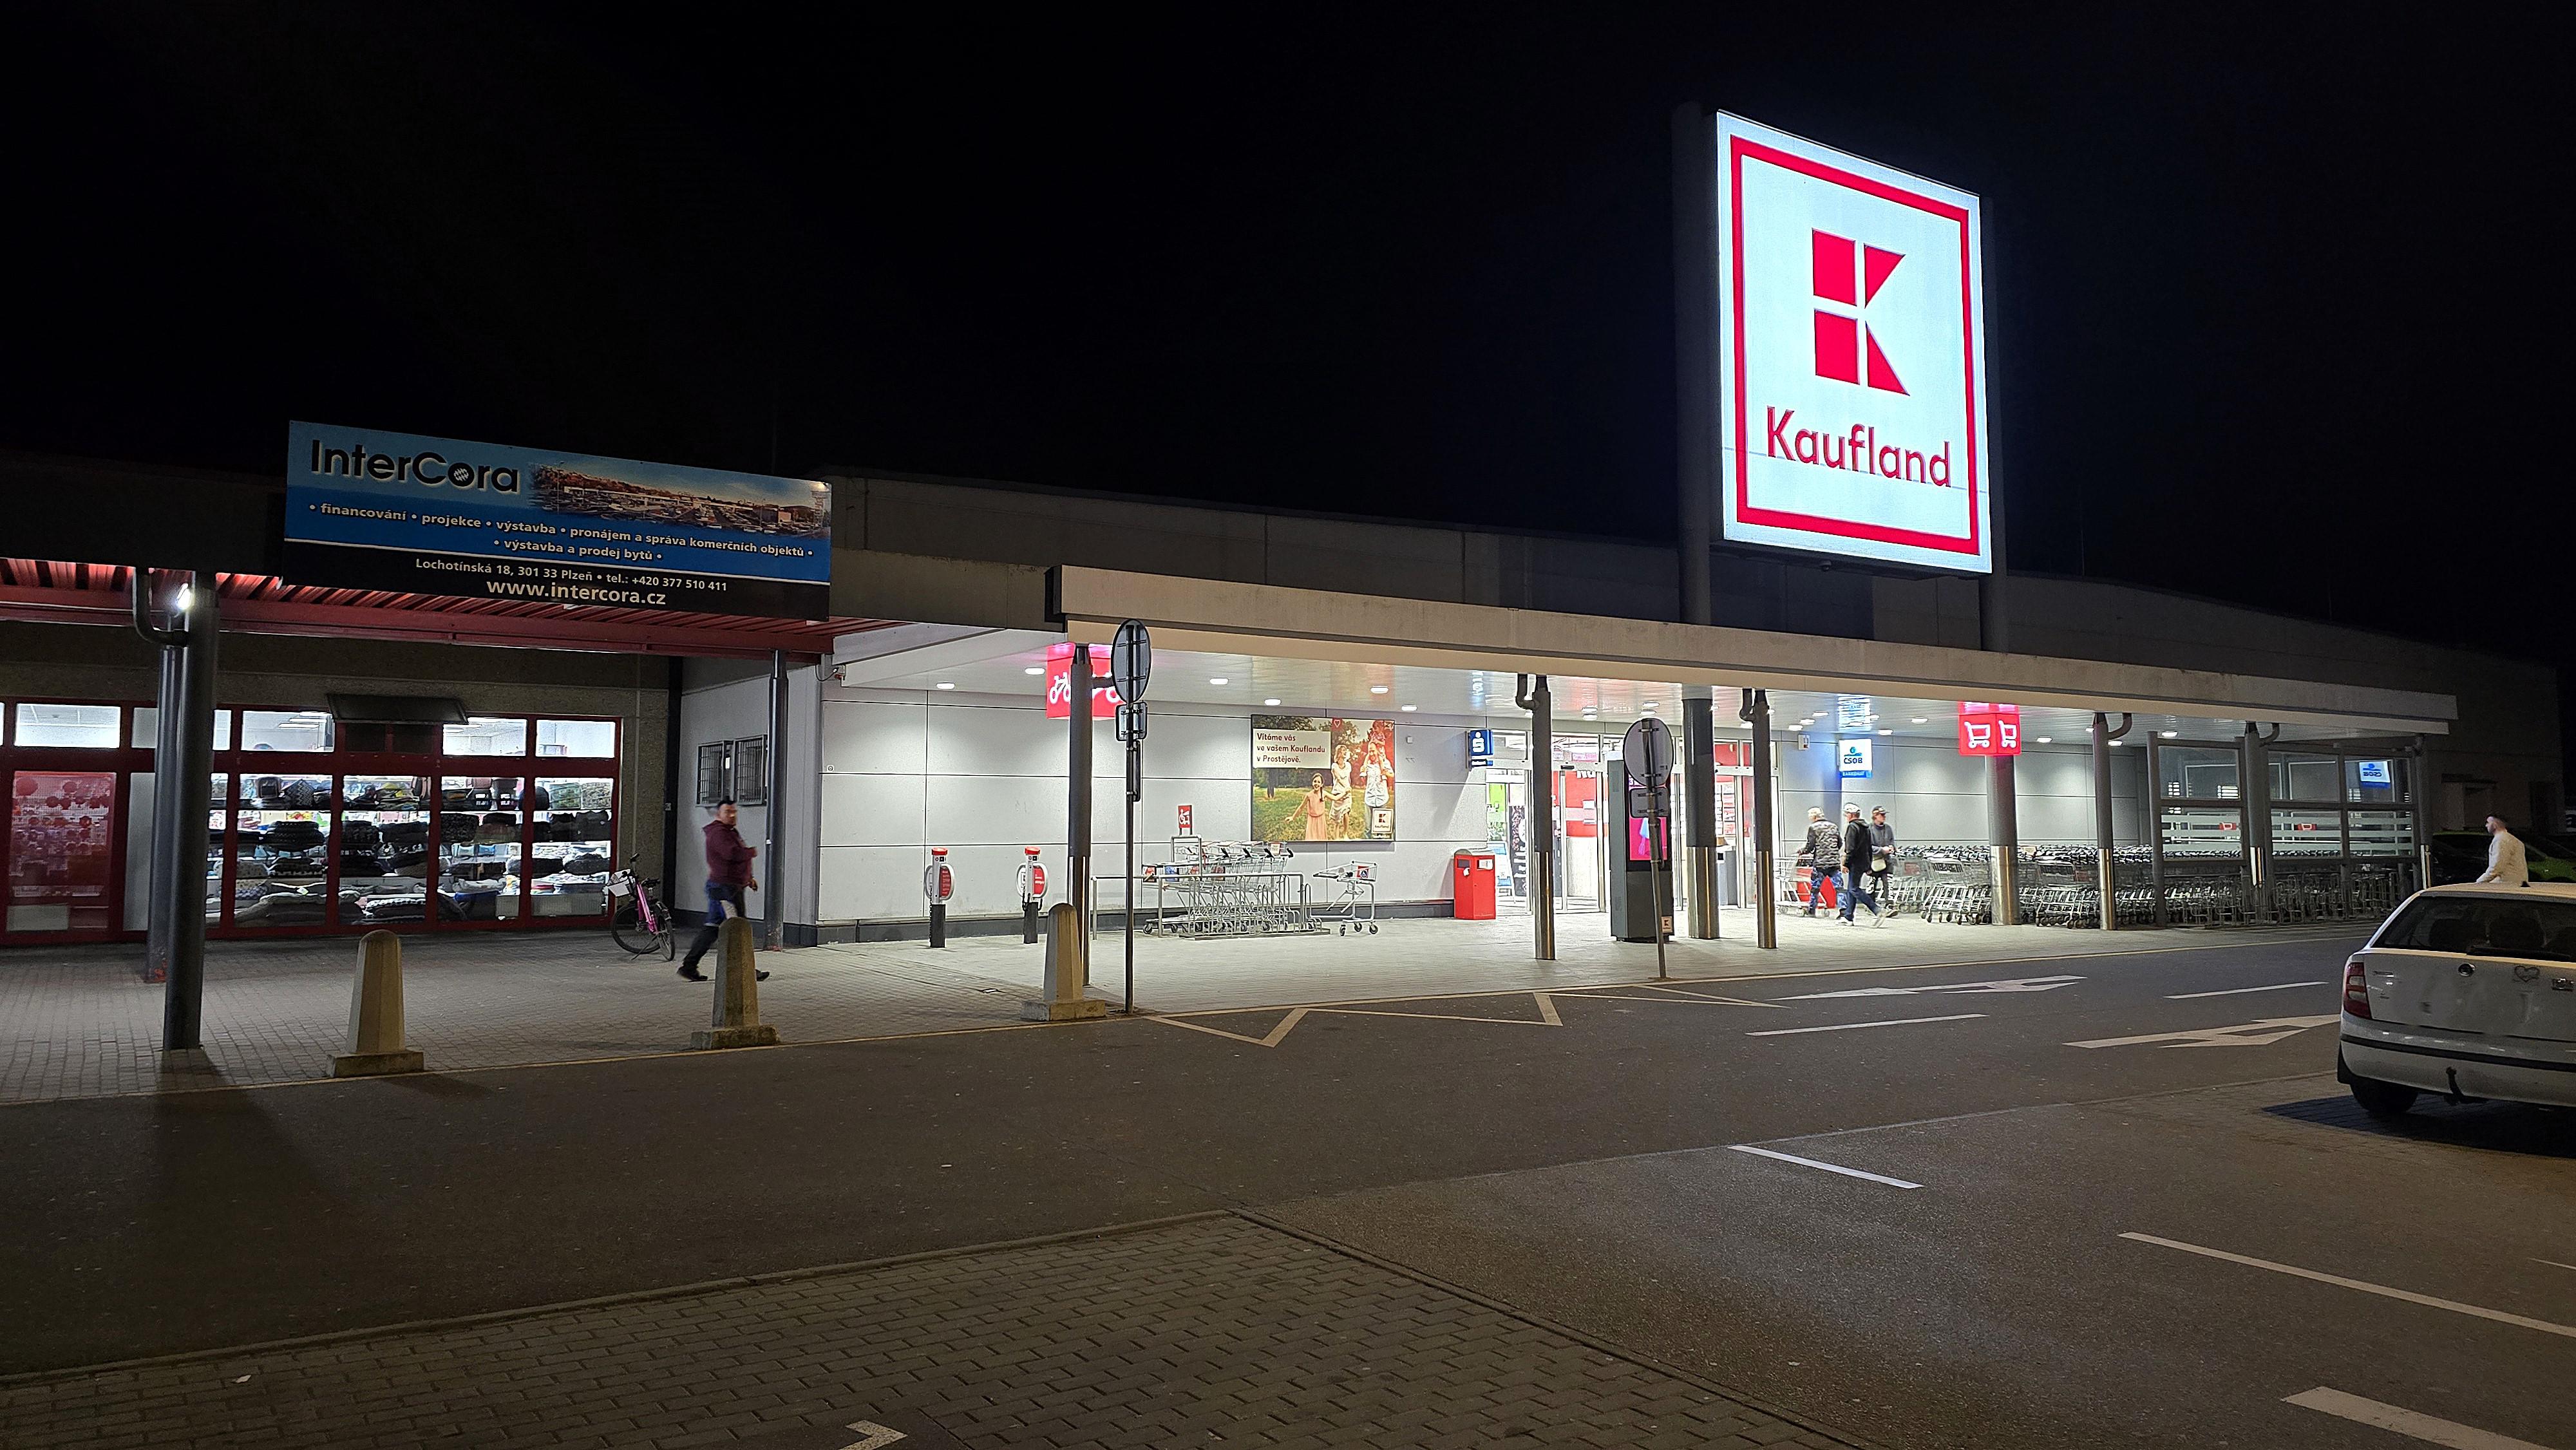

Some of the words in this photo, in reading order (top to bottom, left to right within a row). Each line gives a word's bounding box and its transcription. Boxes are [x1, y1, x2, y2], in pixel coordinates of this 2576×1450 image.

[1766, 406, 1951, 487] Kaufland
[311, 439, 519, 493] InterCora
[321, 503, 406, 520] financování
[422, 514, 481, 527] projekce
[497, 520, 556, 534] výstavba
[570, 528, 631, 541] pronájem
[645, 535, 686, 546] správa
[690, 537, 757, 552] komerčních
[761, 545, 804, 556] objektů
[504, 540, 563, 552] výstavba
[579, 546, 620, 559] prodej
[624, 549, 652, 560] bytů
[416, 558, 492, 574] Lochotínská
[497, 565, 513, 576] 18,
[518, 567, 538, 577] 301
[543, 569, 557, 578] 33
[562, 570, 592, 581] Plzeň
[606, 574, 629, 583] tel.:
[632, 576, 659, 586] +420
[662, 578, 682, 587] 377
[685, 579, 705, 589] 510
[708, 581, 726, 591] 411
[487, 581, 666, 605] www.intercora.cz
[1257, 733, 1282, 741] Vítáme
